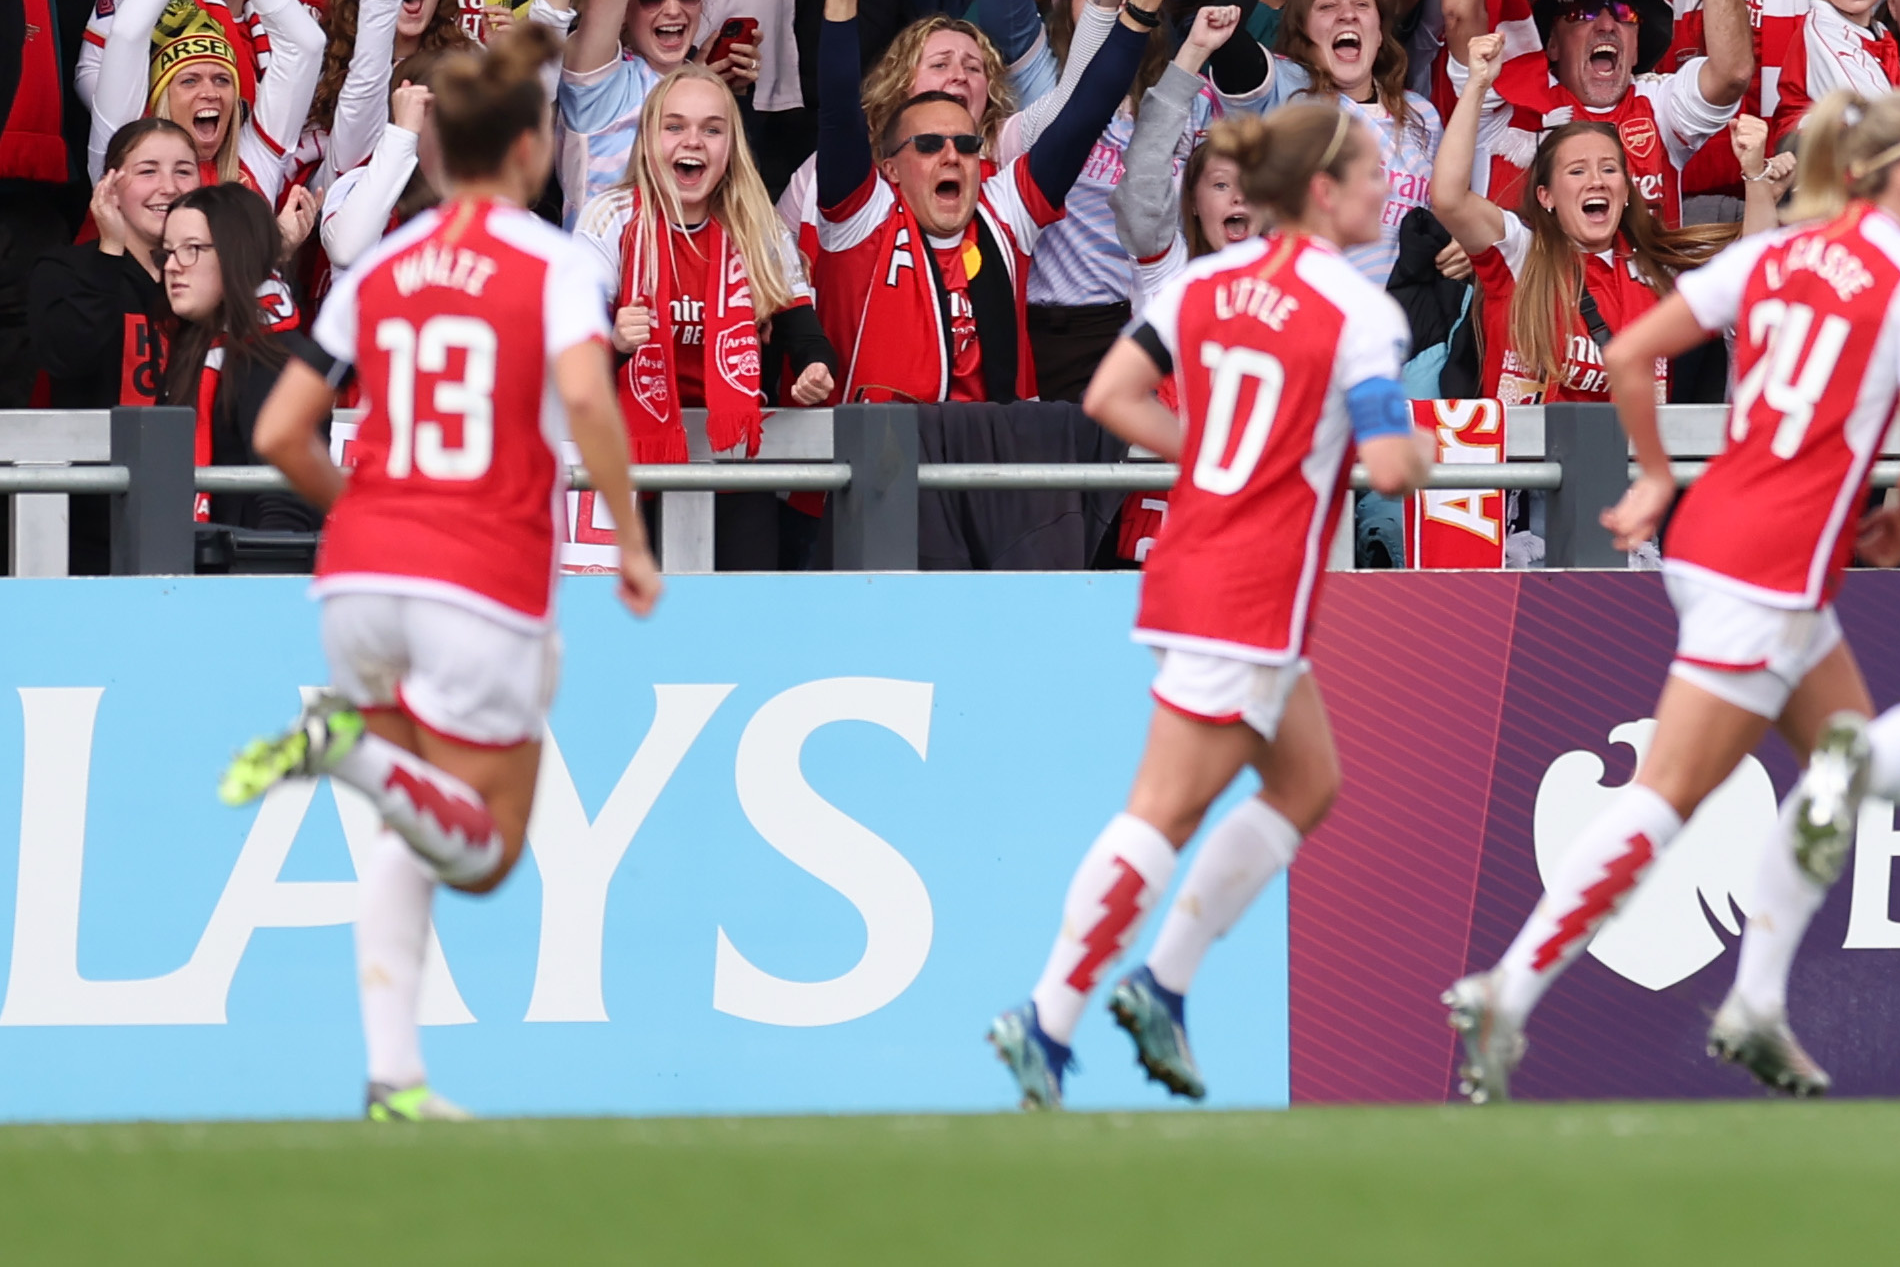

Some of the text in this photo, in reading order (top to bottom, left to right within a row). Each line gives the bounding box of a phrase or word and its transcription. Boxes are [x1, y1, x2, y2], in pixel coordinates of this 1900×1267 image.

[1215, 277, 1301, 333] LITTLE
[1731, 299, 1850, 460] 24
[376, 315, 498, 481] 13
